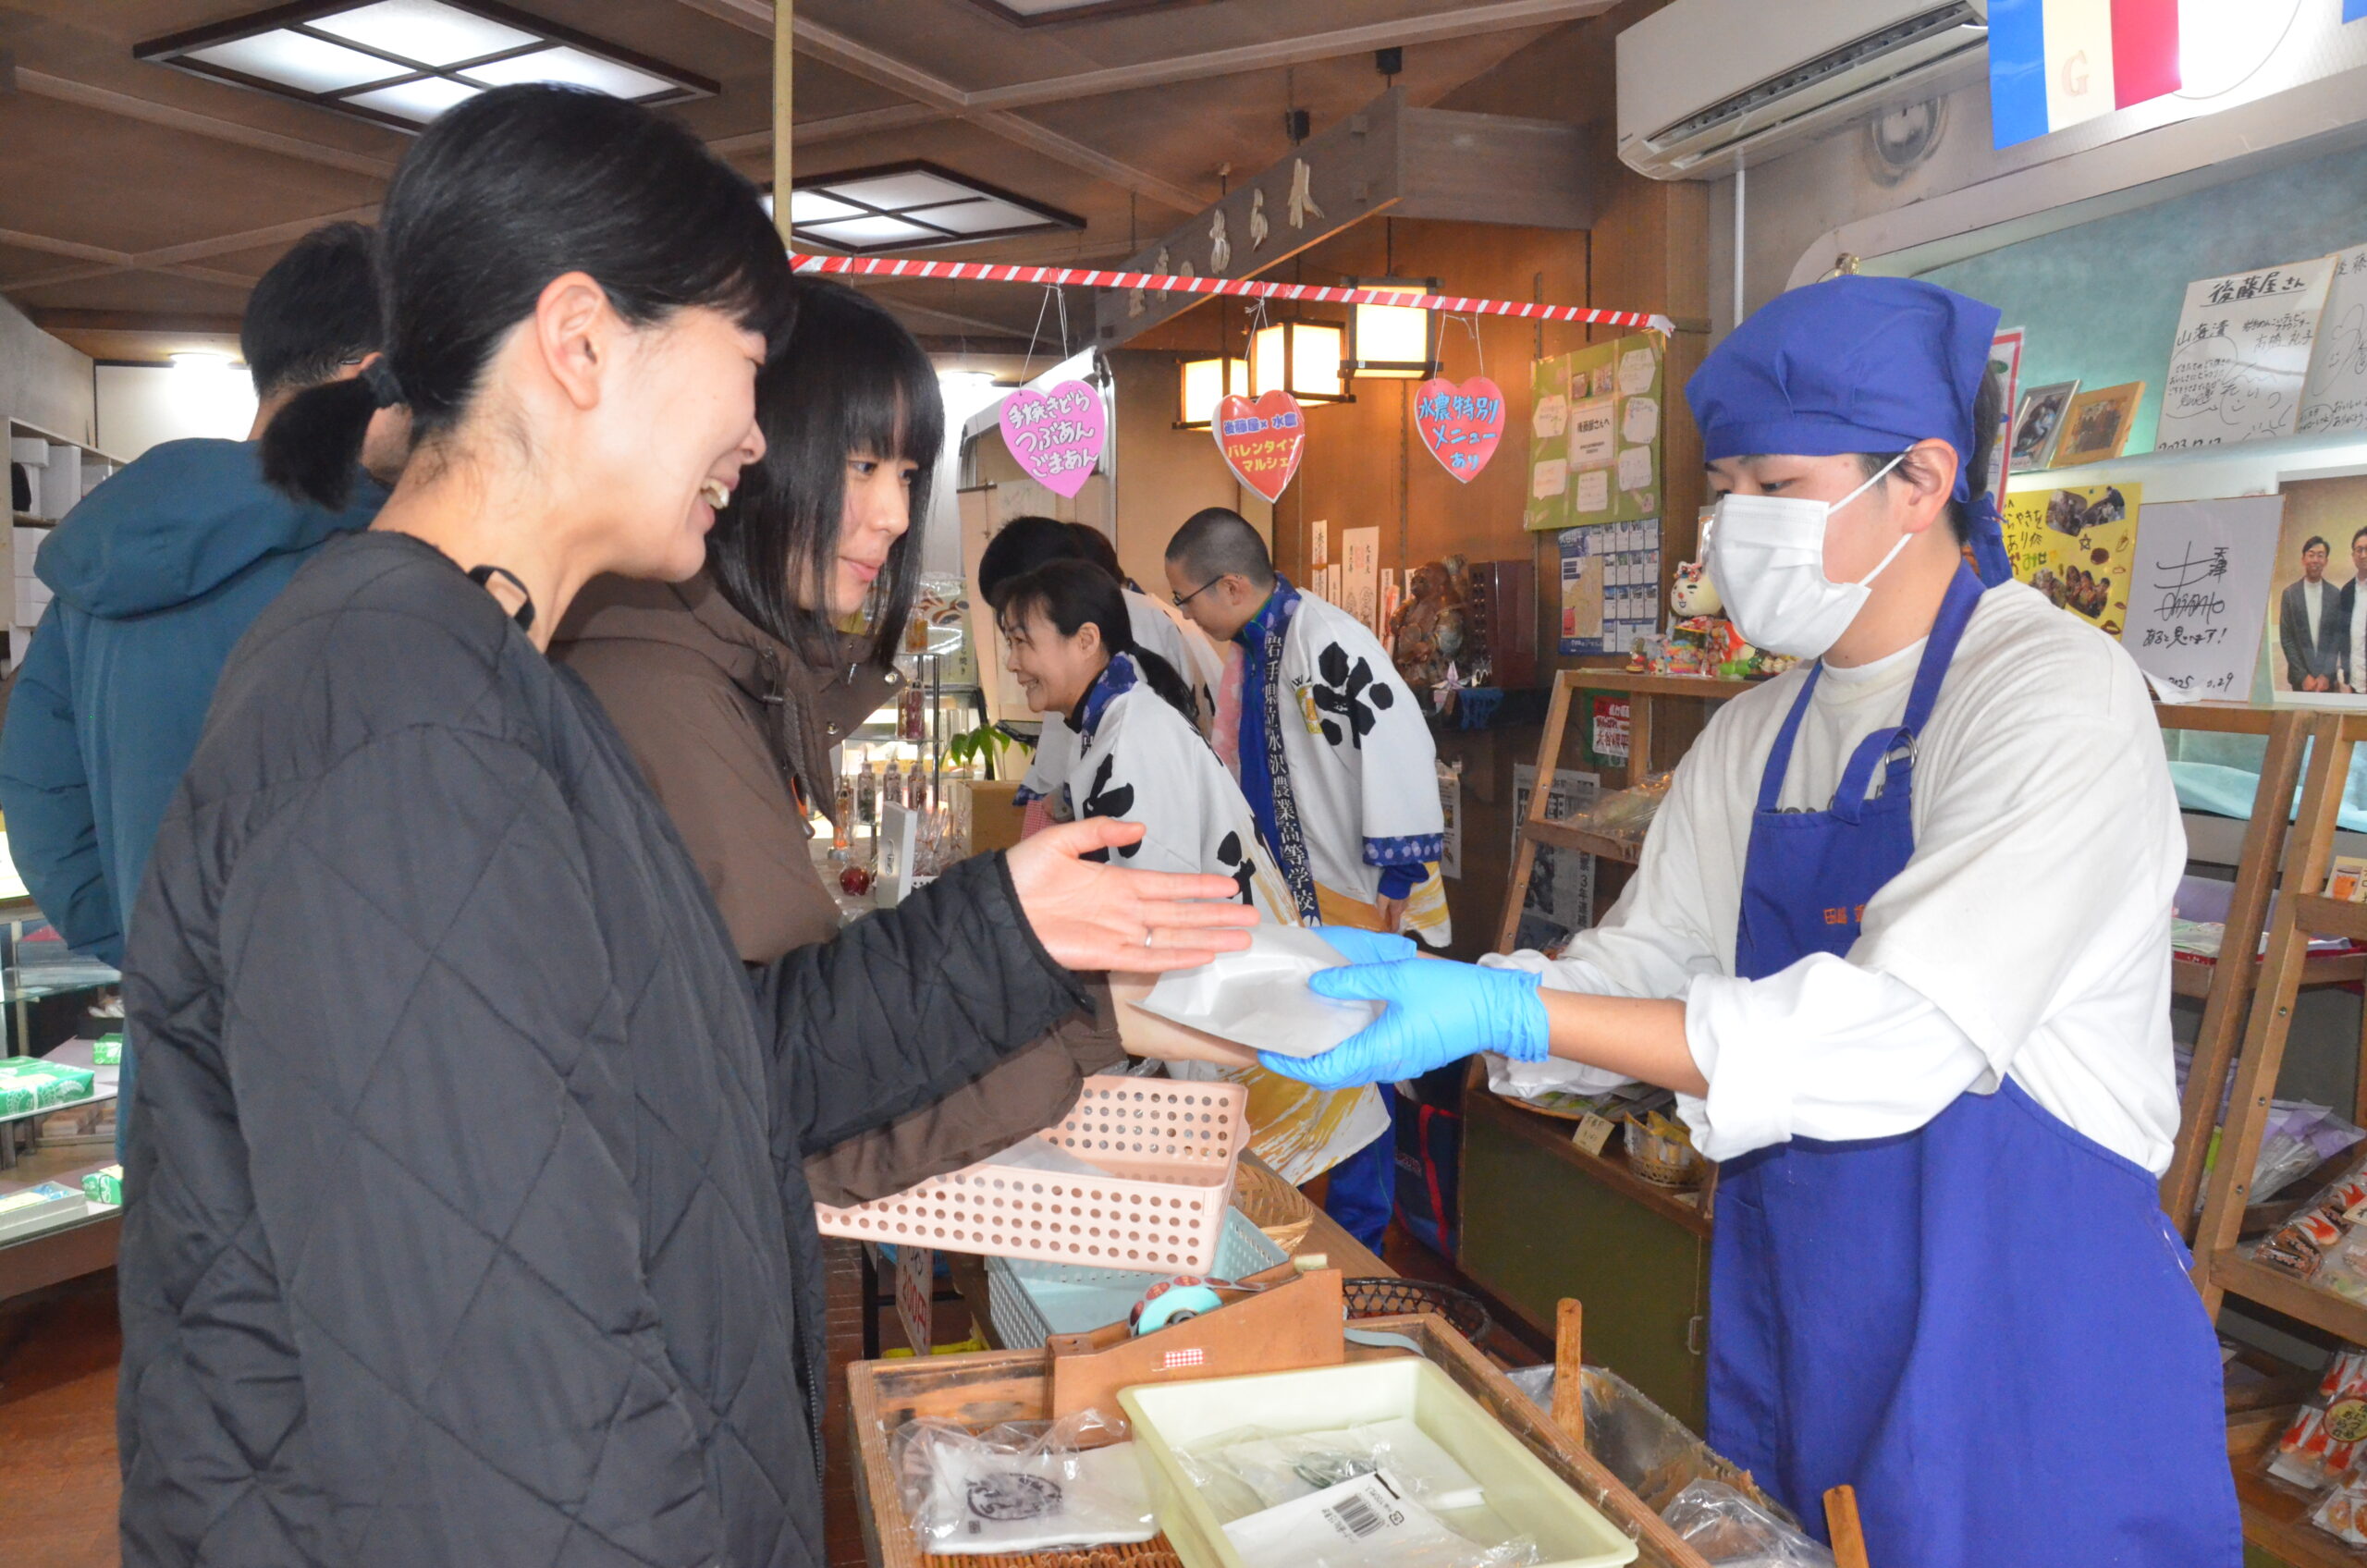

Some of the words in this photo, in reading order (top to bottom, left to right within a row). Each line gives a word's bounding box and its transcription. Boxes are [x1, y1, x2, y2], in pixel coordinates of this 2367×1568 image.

[2062, 50, 2089, 98] G
[2208, 271, 2305, 303] 後藤屋さん
[1008, 389, 1090, 429] 手焼きどら
[1418, 391, 1499, 423] 水農特別
[1015, 422, 1095, 453] つぶあん
[1228, 438, 1295, 459] バレンタイン
[1431, 423, 1498, 450] メニュー
[1031, 449, 1098, 477] ごまあん
[1242, 457, 1290, 472] マルシェ
[1451, 451, 1478, 471] あり
[1264, 636, 1315, 912] 岩手県立水沢農業高等学校
